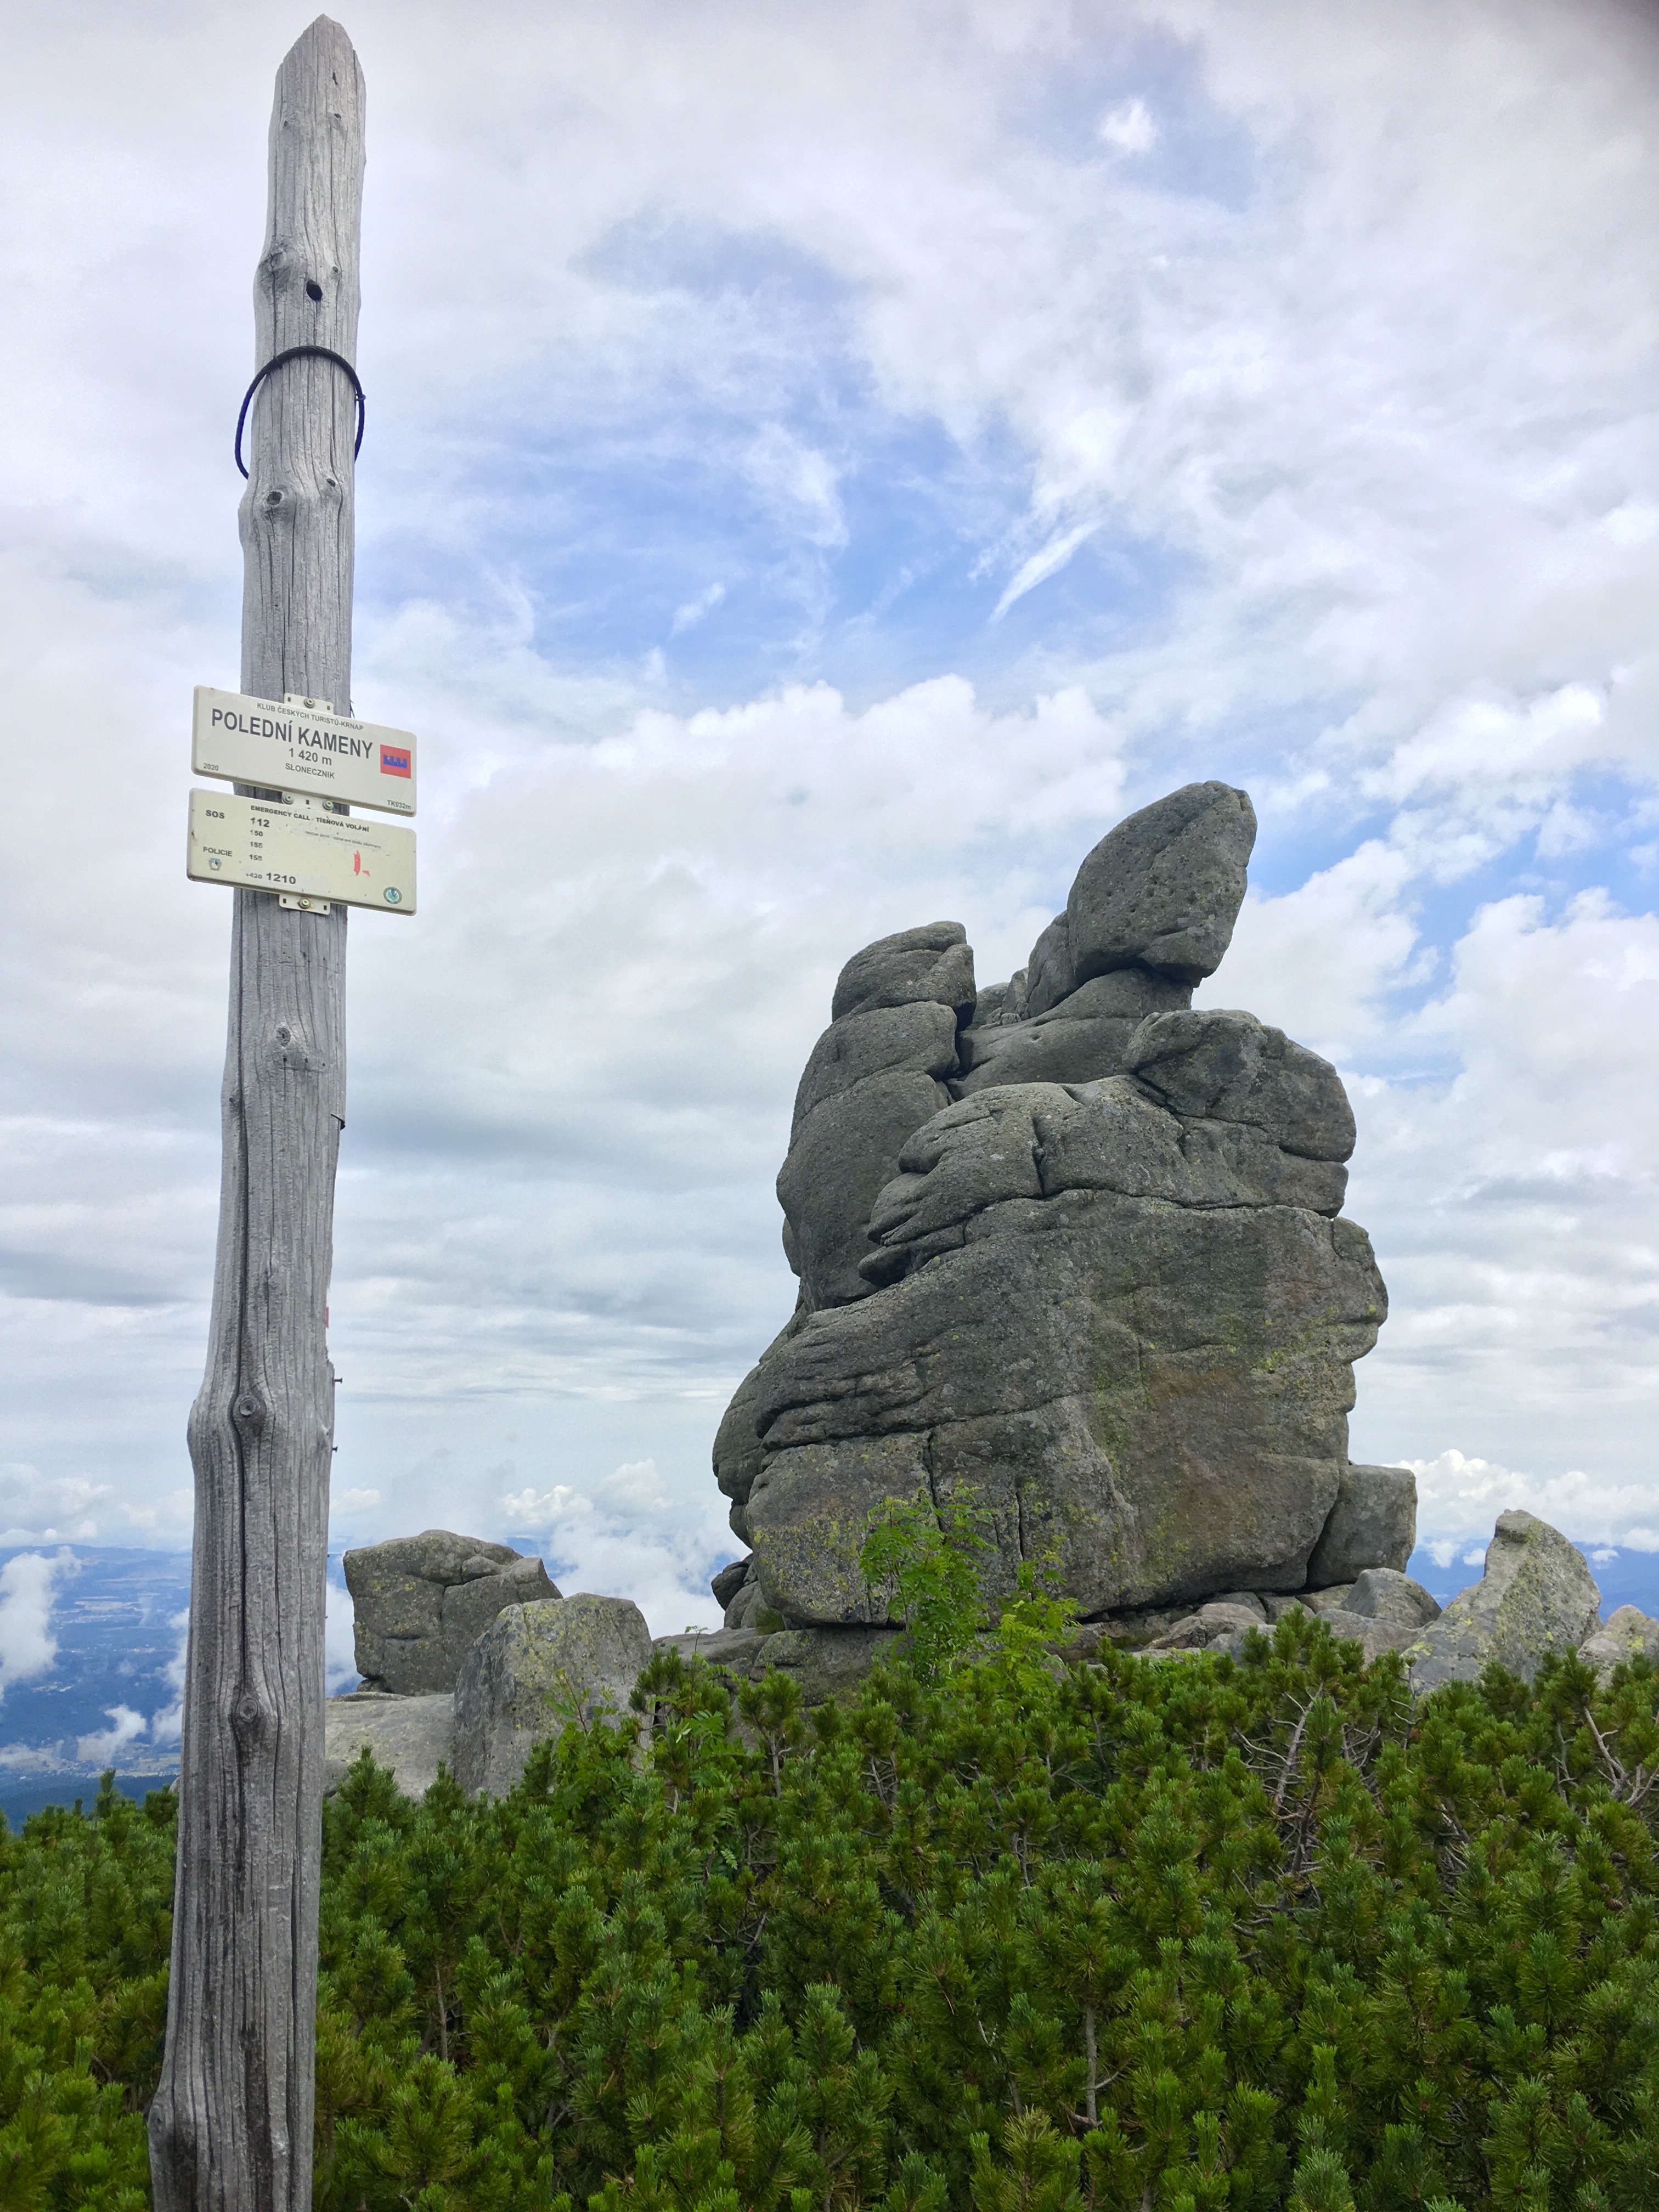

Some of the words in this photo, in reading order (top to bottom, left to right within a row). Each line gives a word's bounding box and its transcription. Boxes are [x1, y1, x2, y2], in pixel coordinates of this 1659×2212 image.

[257, 702, 275, 712] KLUB
[277, 706, 309, 719] ČESKÝCH
[311, 714, 364, 731] TURISTŮ-KRNAP
[212, 708, 293, 742] POLEDNÍ
[298, 726, 373, 759] KAMENY
[289, 747, 294, 758] 1
[298, 750, 318, 763] 420
[321, 757, 332, 766] m
[204, 763, 219, 771] 2020
[387, 799, 411, 810] TK032m
[206, 809, 225, 819] SOS
[250, 805, 292, 818] EMERGENCY
[294, 812, 311, 821] CALL
[250, 817, 270, 828] 112
[203, 847, 233, 857] POLICIE
[266, 872, 296, 884] 1210
